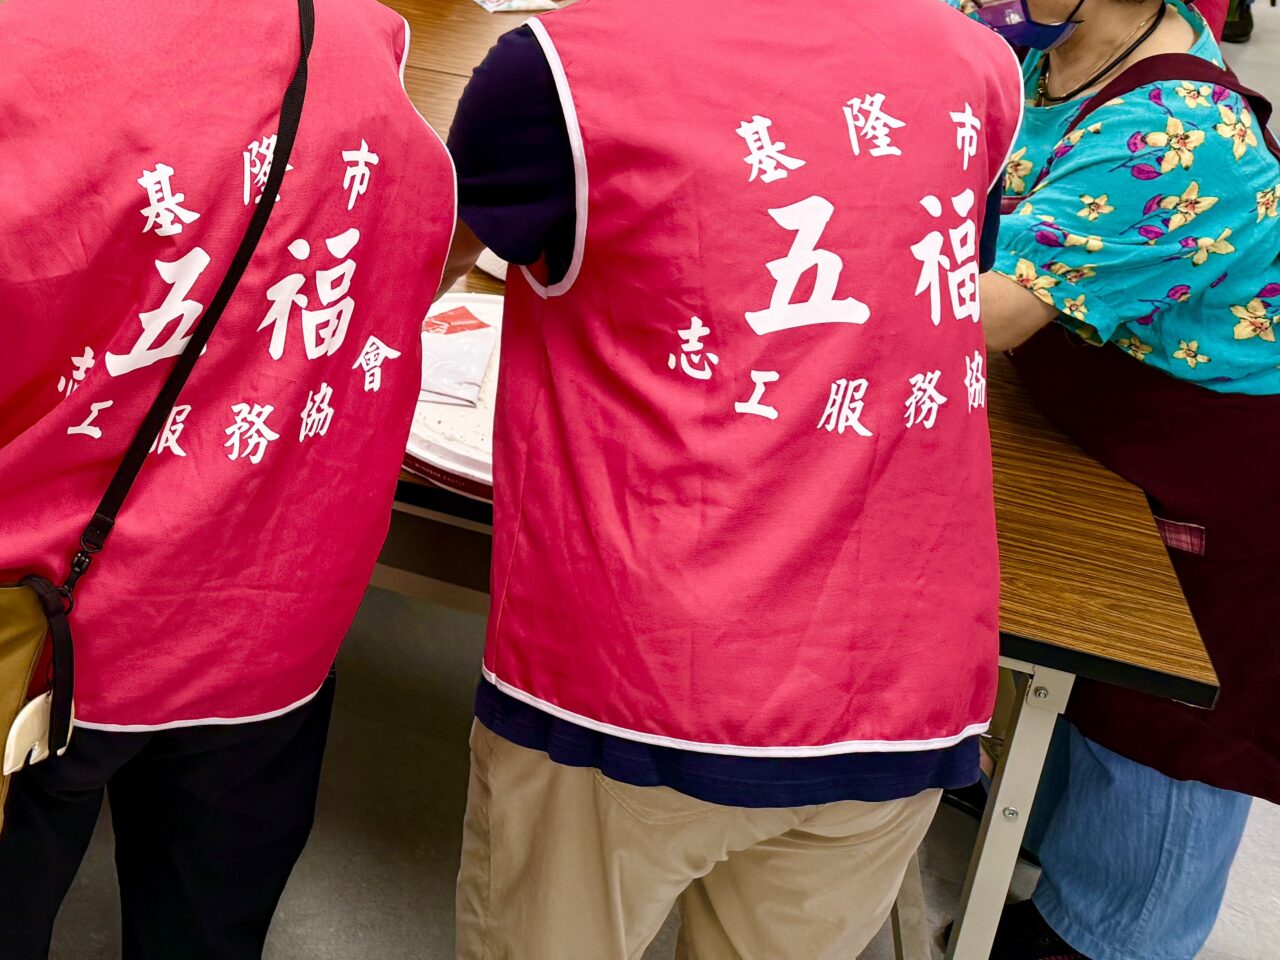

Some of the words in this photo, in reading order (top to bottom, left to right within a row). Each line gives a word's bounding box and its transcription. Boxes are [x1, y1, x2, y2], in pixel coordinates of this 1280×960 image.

[136, 133, 380, 237] 基隆市
[736, 92, 982, 183] 基隆市
[104, 227, 361, 377] 五福
[744, 188, 982, 336] 五福
